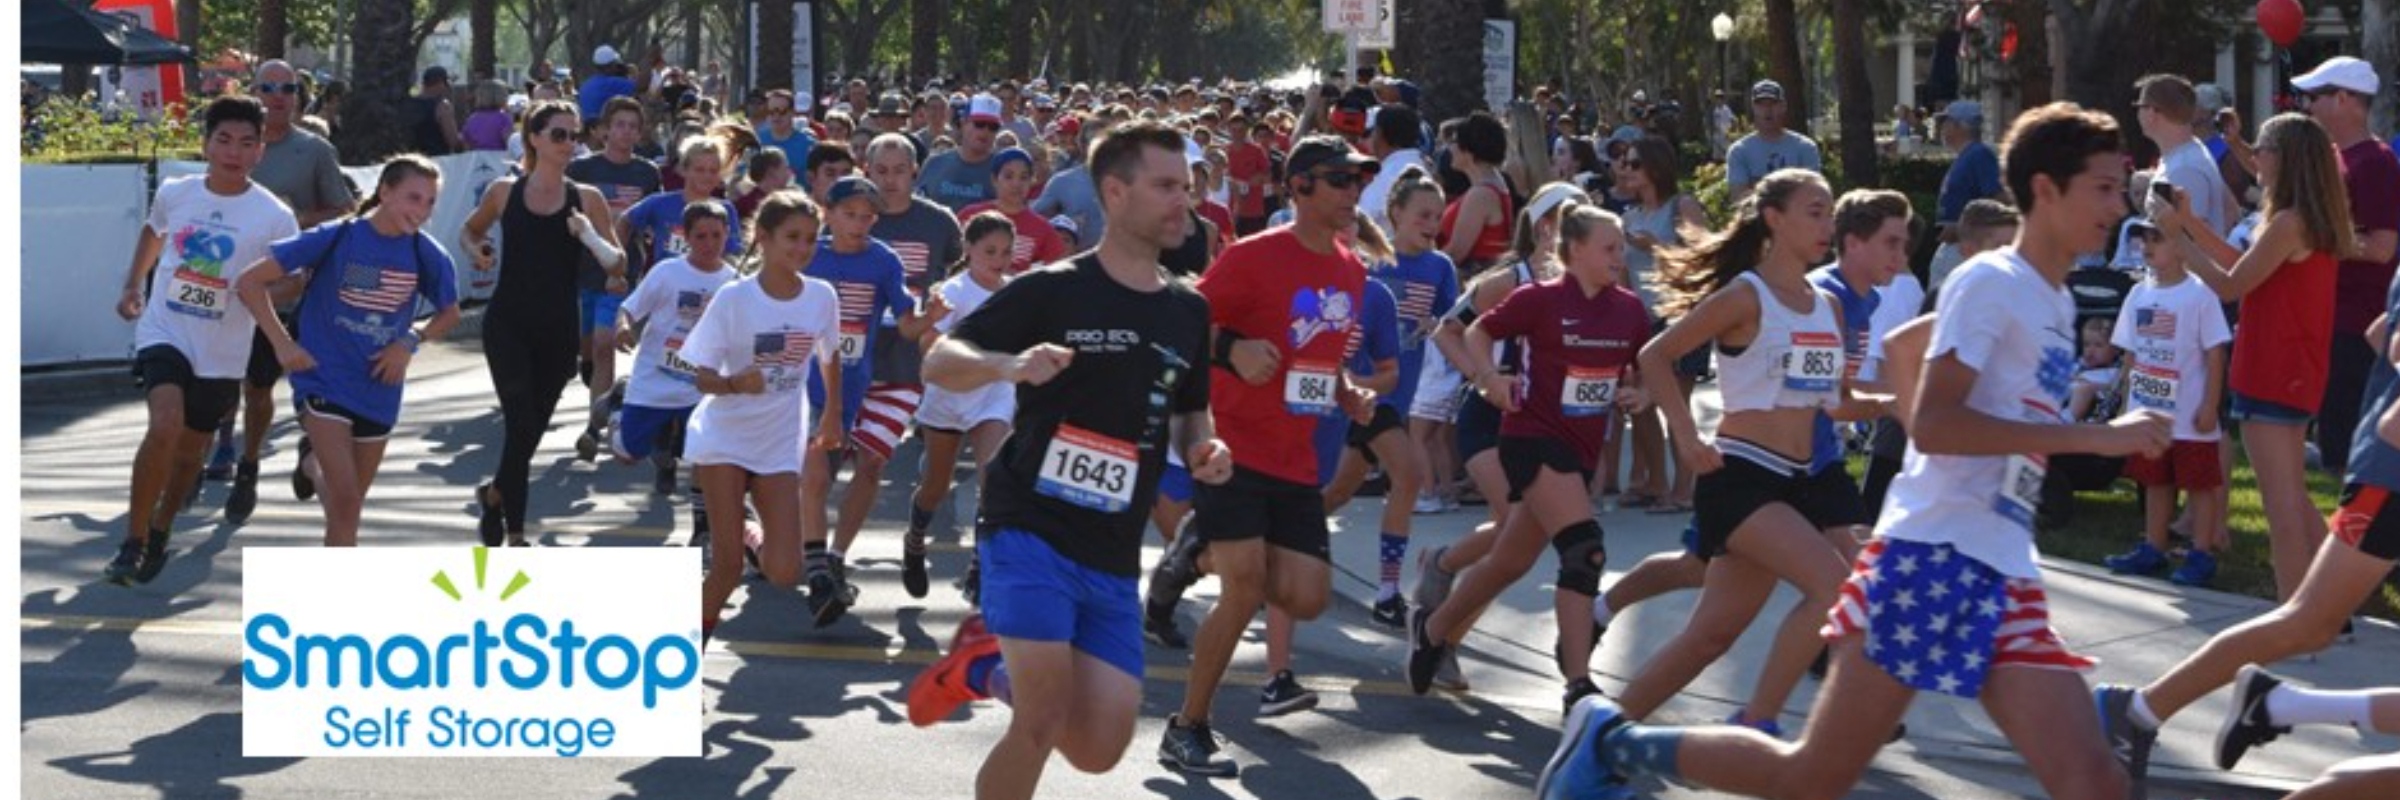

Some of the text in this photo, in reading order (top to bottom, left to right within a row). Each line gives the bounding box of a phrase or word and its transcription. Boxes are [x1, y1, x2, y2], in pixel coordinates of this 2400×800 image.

[179, 283, 216, 307] 236
[1065, 329, 1104, 343] PRO
[1803, 350, 1834, 375] 863
[1299, 377, 1327, 400] 864
[1576, 382, 1609, 402] 682
[1055, 448, 1127, 493] 1643
